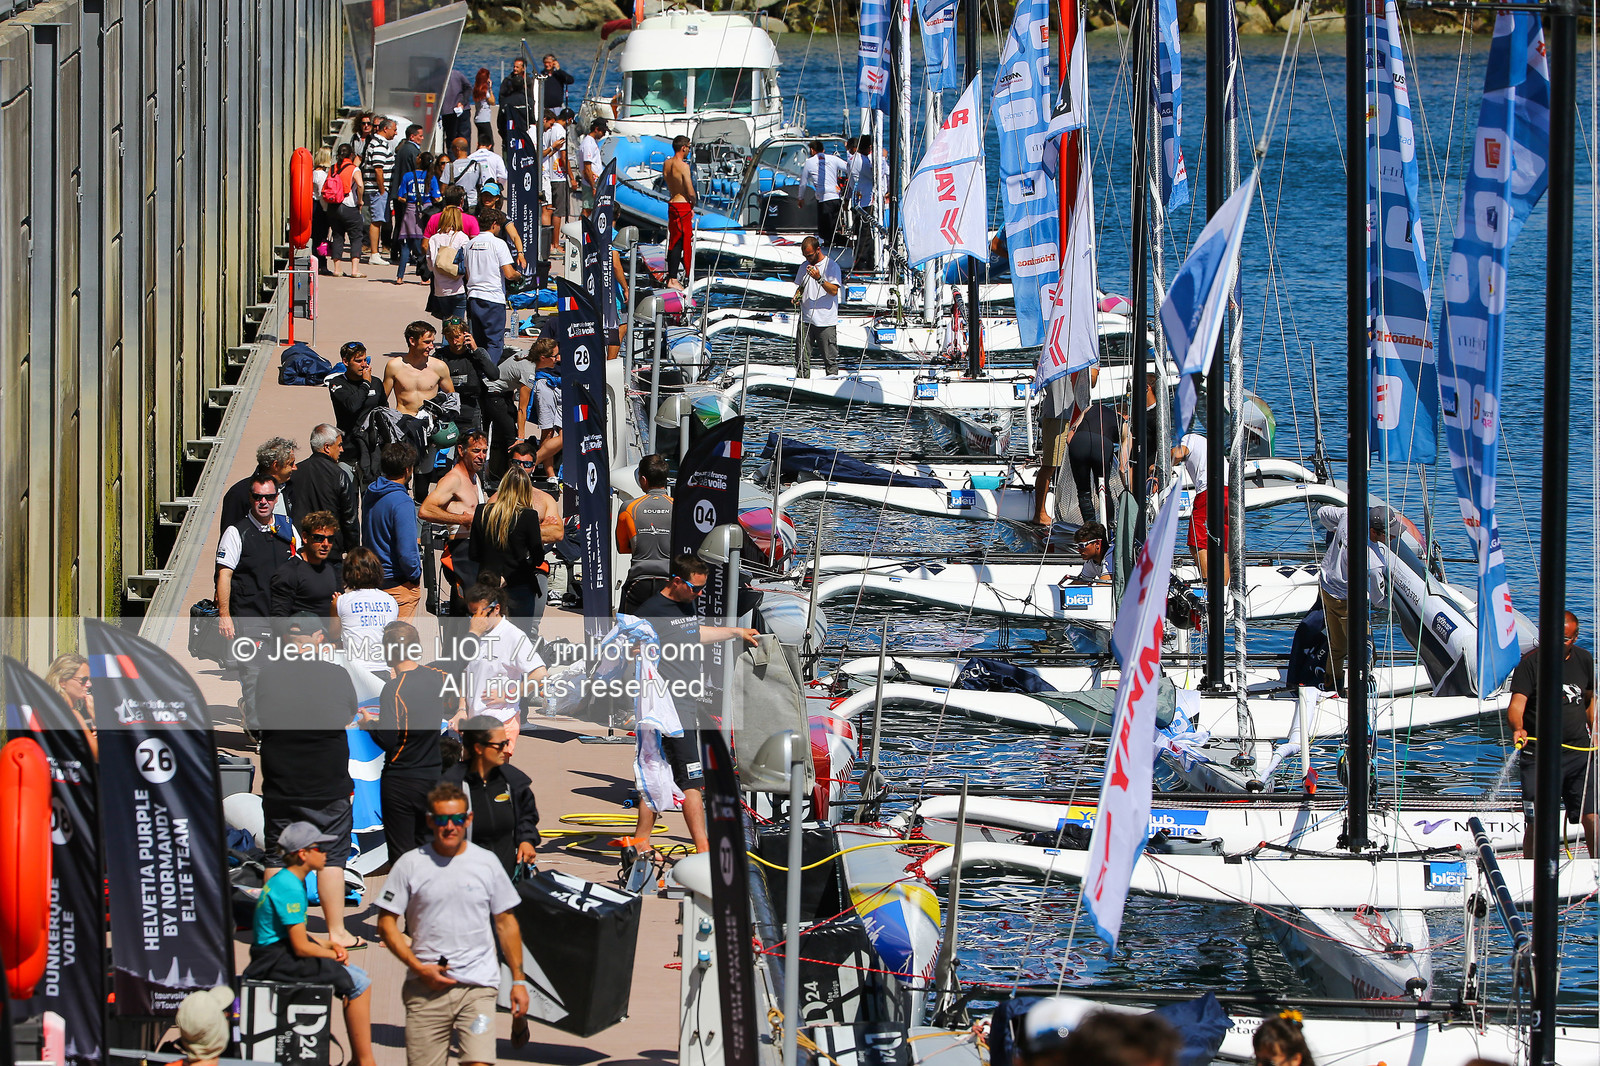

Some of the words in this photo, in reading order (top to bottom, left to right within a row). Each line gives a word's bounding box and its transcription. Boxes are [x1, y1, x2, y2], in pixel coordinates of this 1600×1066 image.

[877, 332, 896, 342] bleu
[1377, 329, 1434, 350] Triominos
[575, 350, 589, 366] 28
[917, 386, 938, 398] bleu
[952, 495, 975, 505] bleu
[695, 505, 715, 526] 04
[351, 602, 364, 614] LES
[364, 601, 384, 613] FILLES
[384, 601, 392, 613] DE
[1065, 594, 1092, 605] bleu
[139, 747, 173, 773] 26
[134, 789, 155, 860] PURPLE
[1149, 813, 1175, 825] lub
[172, 818, 191, 869] TEAM
[154, 803, 178, 909] NORMANDY
[1432, 872, 1466, 886] bleu
[140, 863, 160, 951] HELVETIA
[178, 873, 197, 922] ELITE
[162, 913, 179, 937] BY
[46, 877, 60, 998] DUNKERQUE
[62, 910, 75, 967] VOILE
